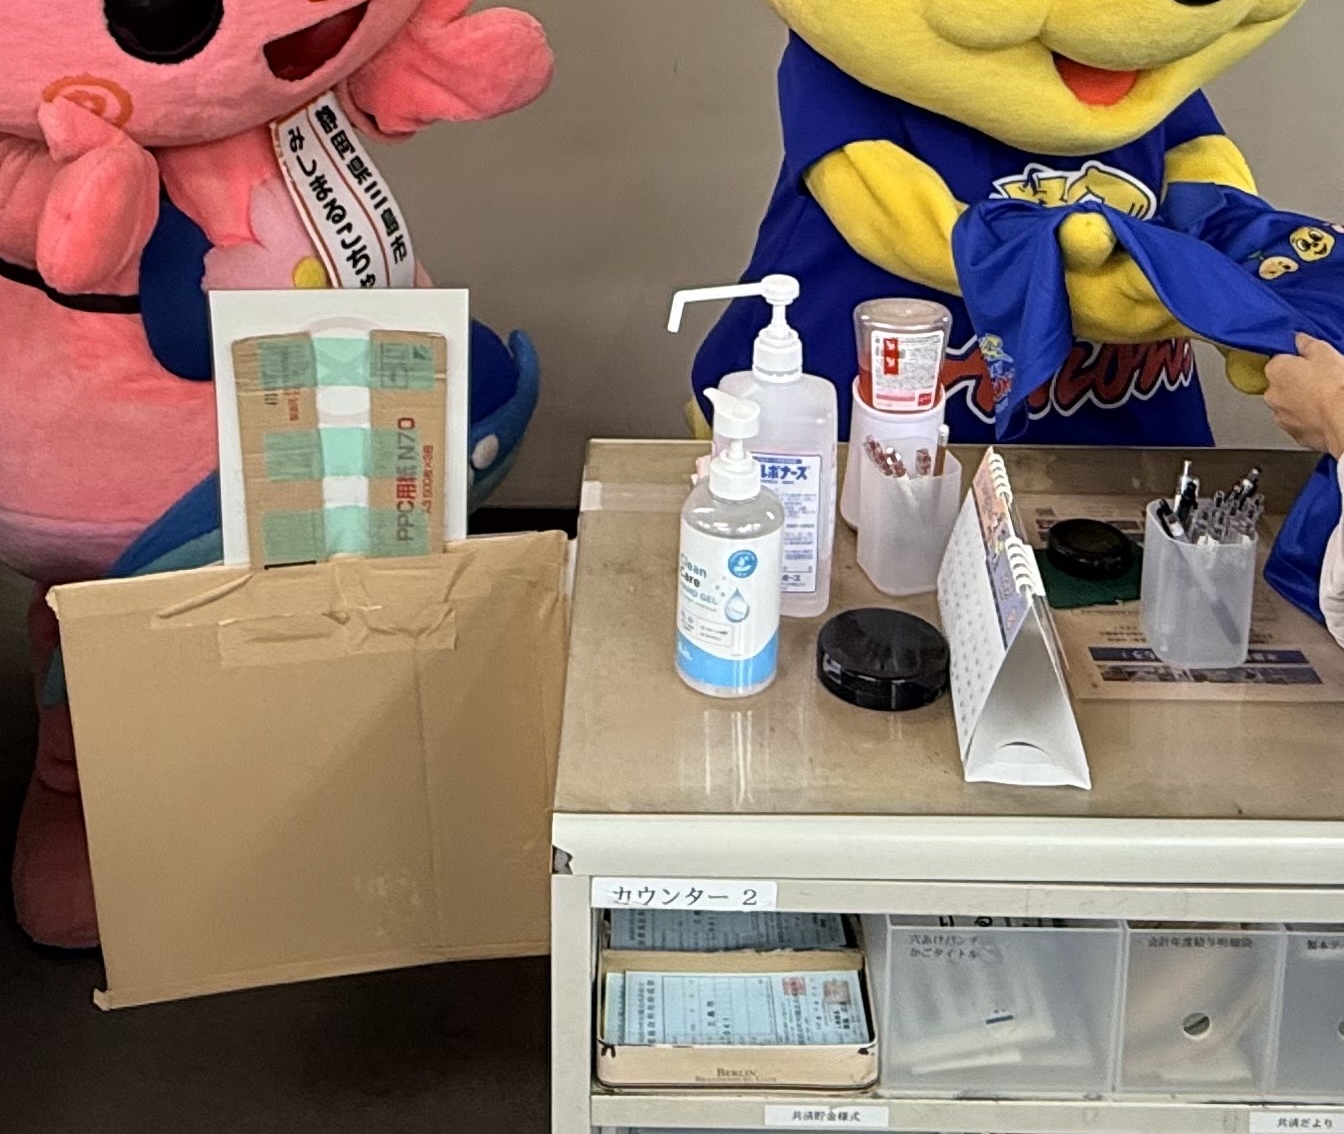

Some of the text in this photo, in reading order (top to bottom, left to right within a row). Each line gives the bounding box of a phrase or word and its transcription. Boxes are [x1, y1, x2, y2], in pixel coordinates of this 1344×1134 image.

[396, 417, 417, 460] N70
[612, 886, 758, 906] カウンター 2
